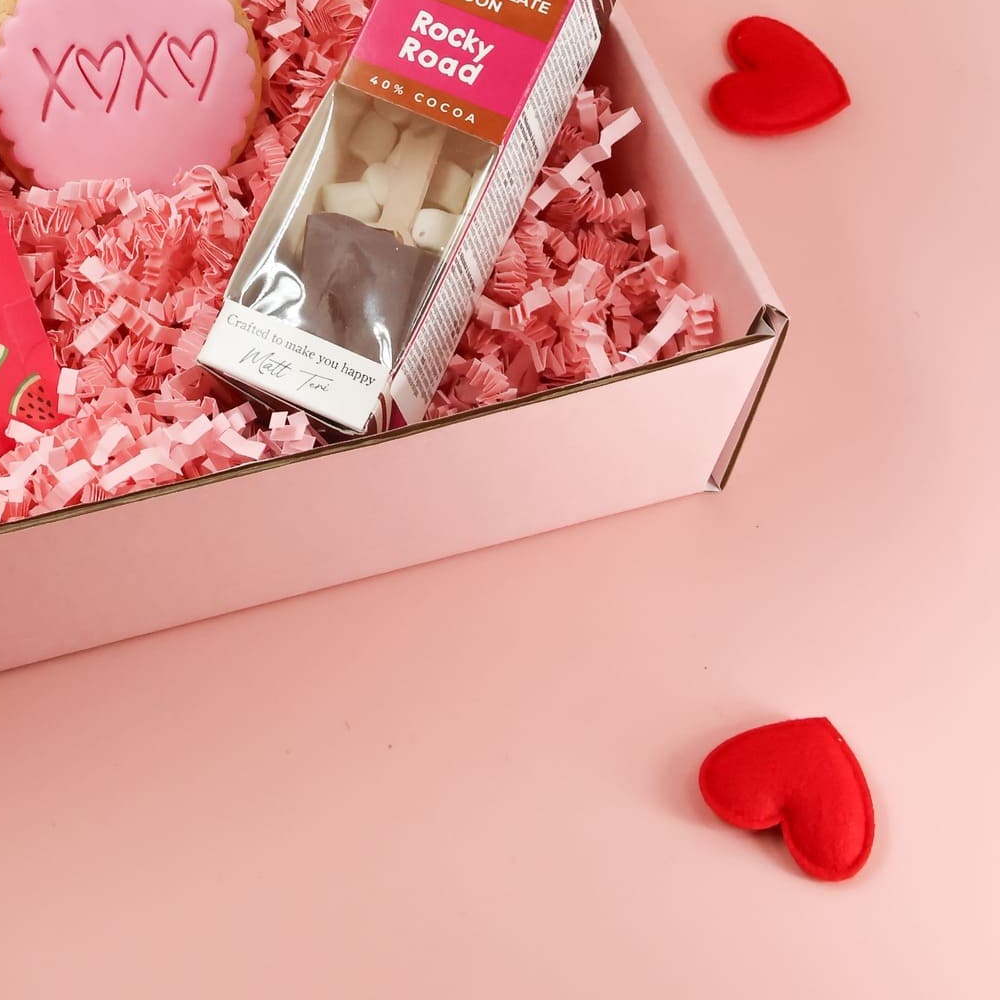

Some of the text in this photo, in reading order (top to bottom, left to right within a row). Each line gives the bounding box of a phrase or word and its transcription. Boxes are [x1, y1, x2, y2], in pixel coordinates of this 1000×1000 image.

[398, 36, 484, 85] Road
[411, 10, 495, 63] Rocky
[369, 75, 475, 124] 40% COCOA
[226, 313, 376, 386] Crafted to make you happy
[238, 346, 292, 378] Matt
